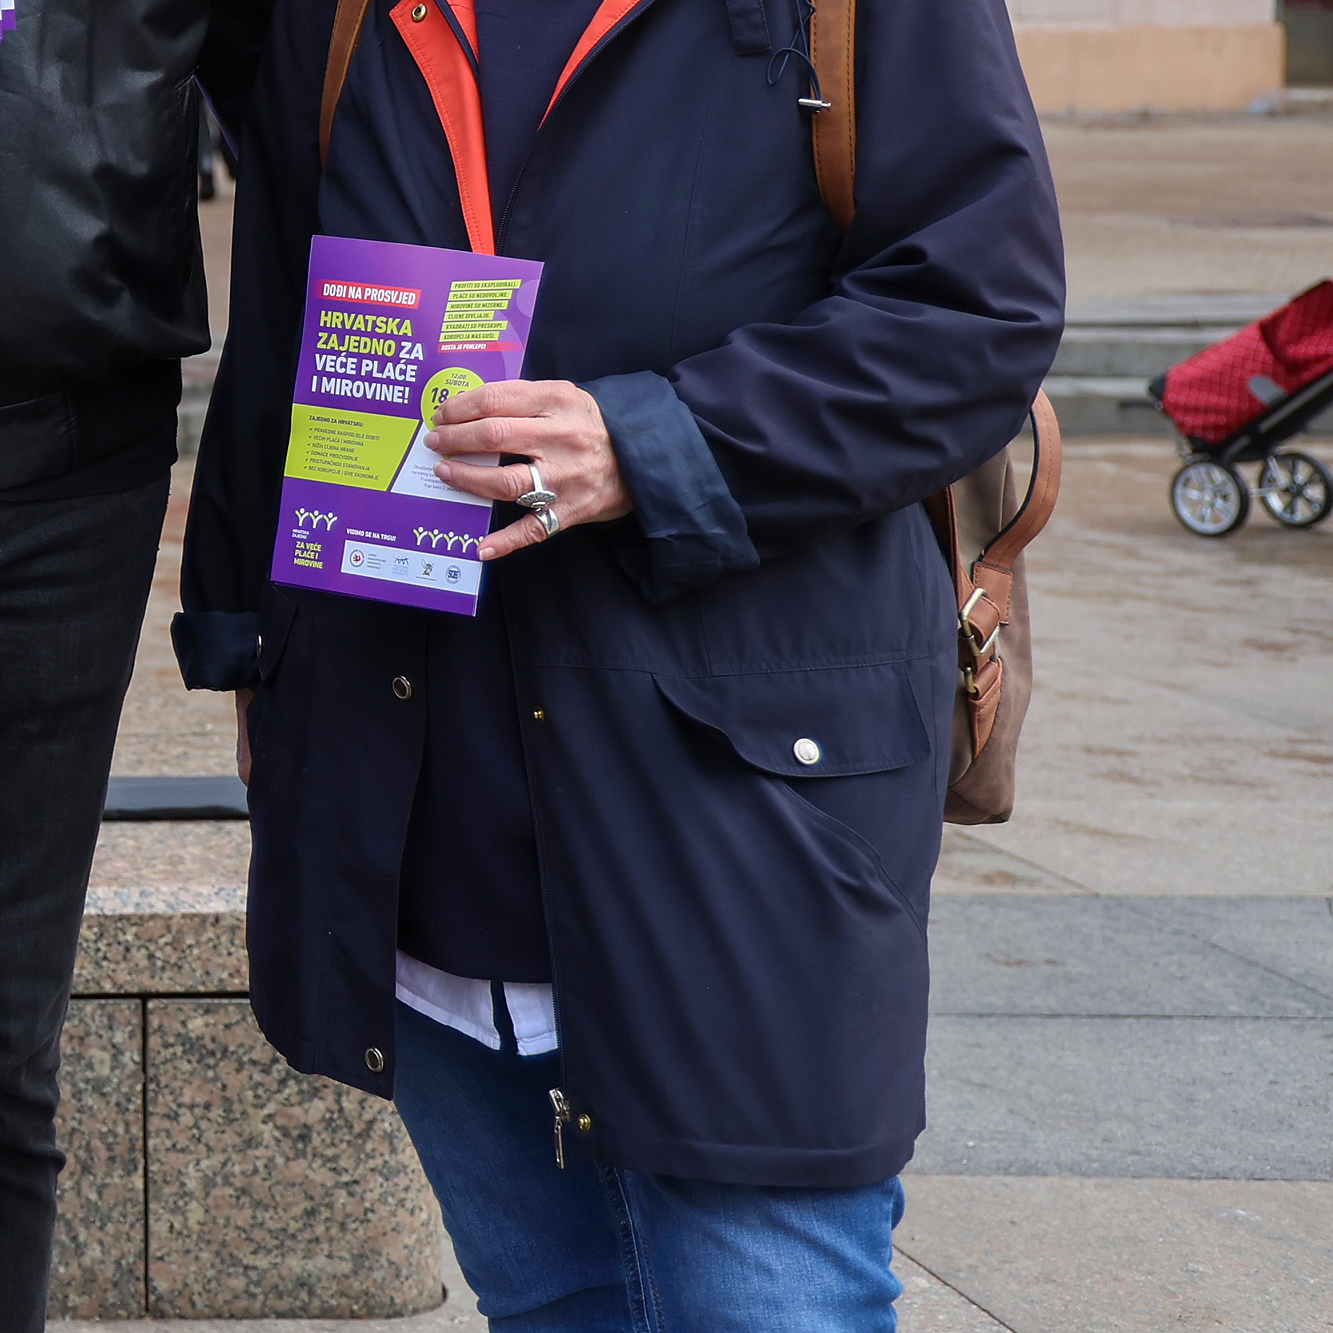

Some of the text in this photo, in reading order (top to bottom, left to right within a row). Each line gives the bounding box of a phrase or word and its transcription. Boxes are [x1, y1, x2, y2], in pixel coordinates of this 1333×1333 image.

[323, 283, 416, 305] DOĐI NA PROSVJED
[319, 310, 415, 337] HRVATSKA
[316, 332, 426, 361] ZAJEDNO ZA
[313, 349, 418, 382] VEĆE PLAĆE
[312, 376, 410, 404] I MIROVINE!
[445, 379, 469, 387] SUBOTA
[431, 387, 449, 404] 18
[346, 528, 365, 536] VIDIMO
[380, 534, 396, 542] TRGU!
